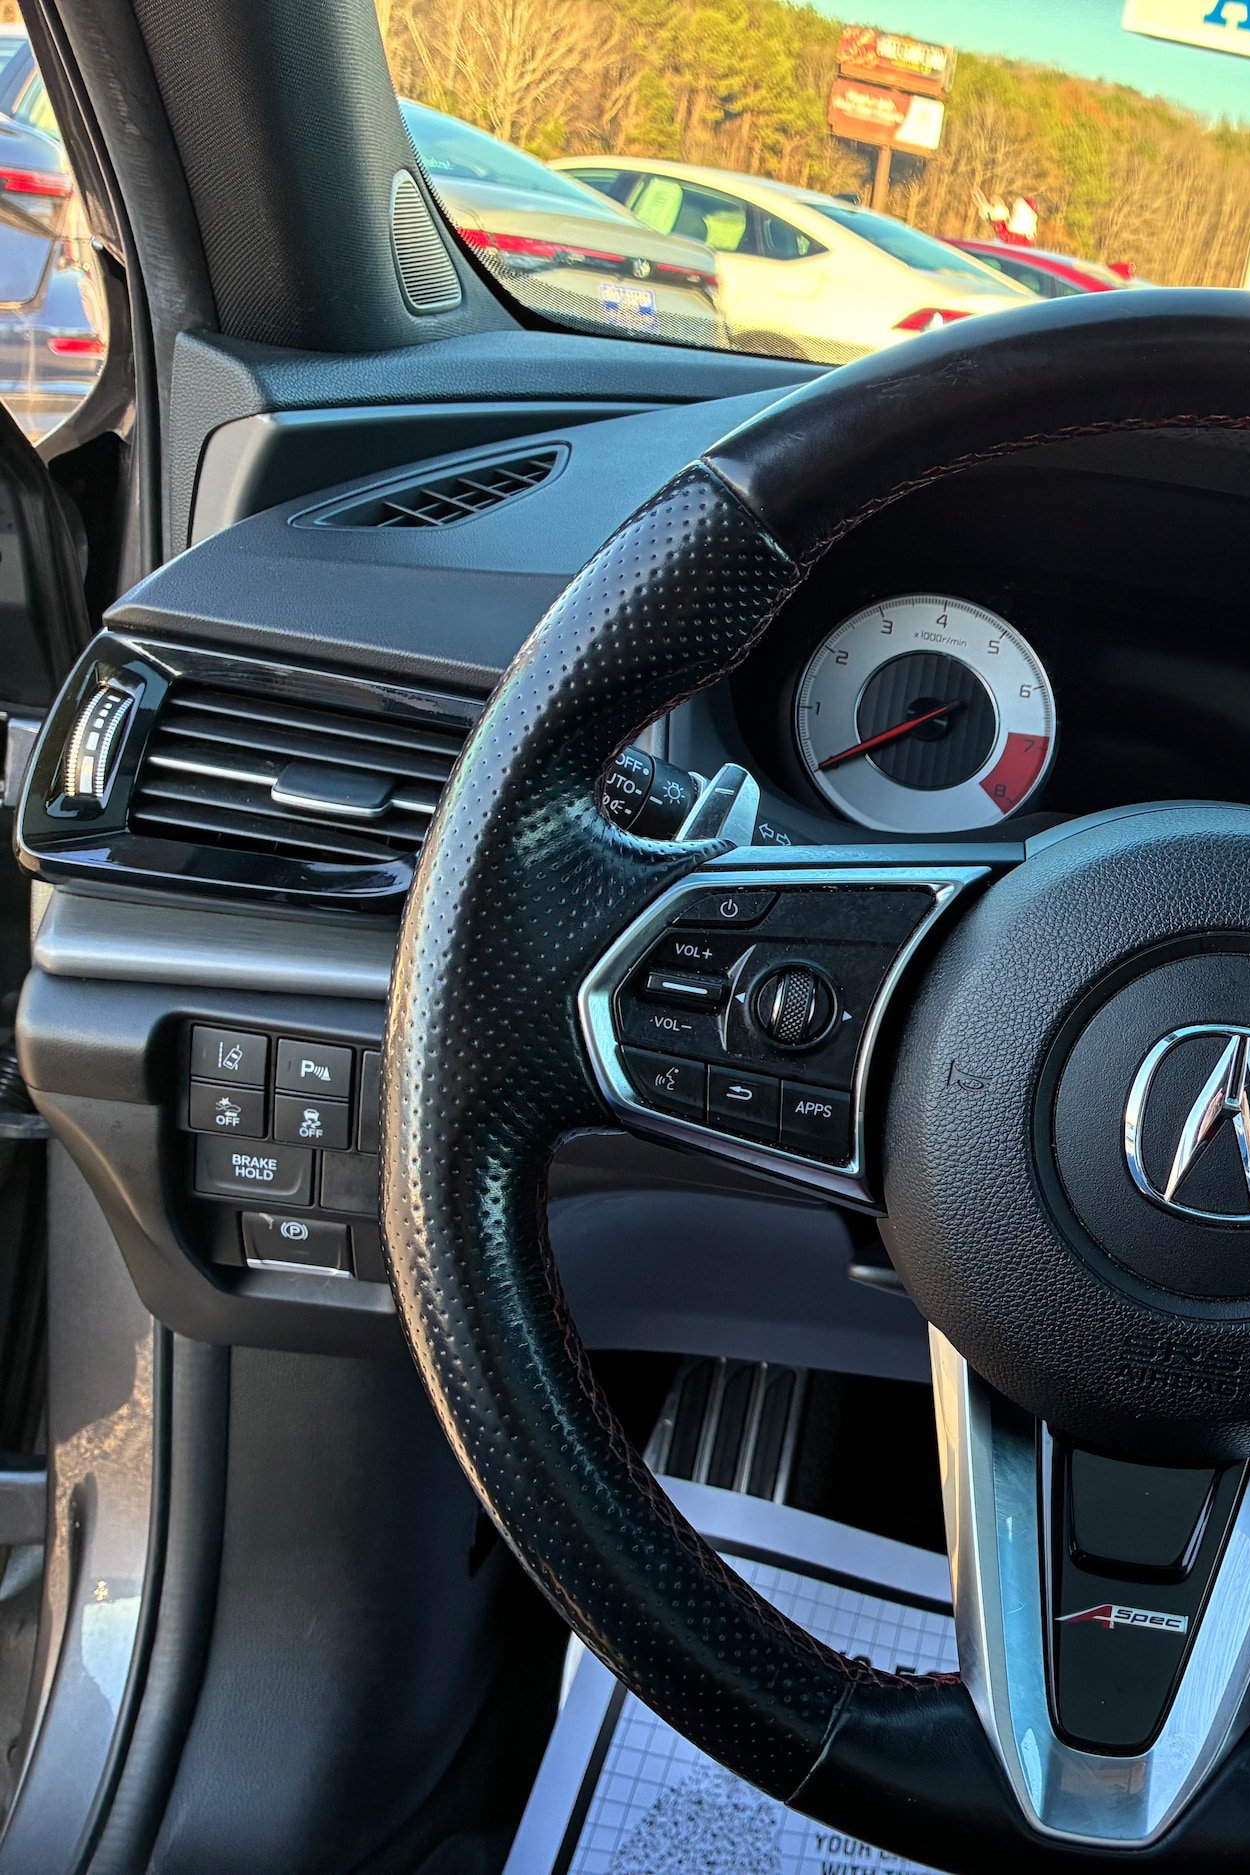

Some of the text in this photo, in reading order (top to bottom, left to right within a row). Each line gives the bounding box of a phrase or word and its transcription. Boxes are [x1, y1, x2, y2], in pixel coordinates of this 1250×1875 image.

[881, 620, 893, 635] 3
[936, 614, 948, 628] 4
[987, 640, 1000, 655] 5
[835, 652, 849, 665] 2
[1019, 684, 1032, 698] 6
[814, 702, 821, 715] 1
[1023, 739, 1036, 752] 7
[607, 772, 636, 794] UTO
[993, 784, 1007, 797] 8
[301, 1060, 314, 1077] P
[795, 1101, 832, 1118] APPS
[216, 1115, 240, 1127] OFF
[299, 1127, 323, 1139] OFF
[232, 1153, 277, 1171] BRAKE
[235, 1166, 274, 1181] HOLD
